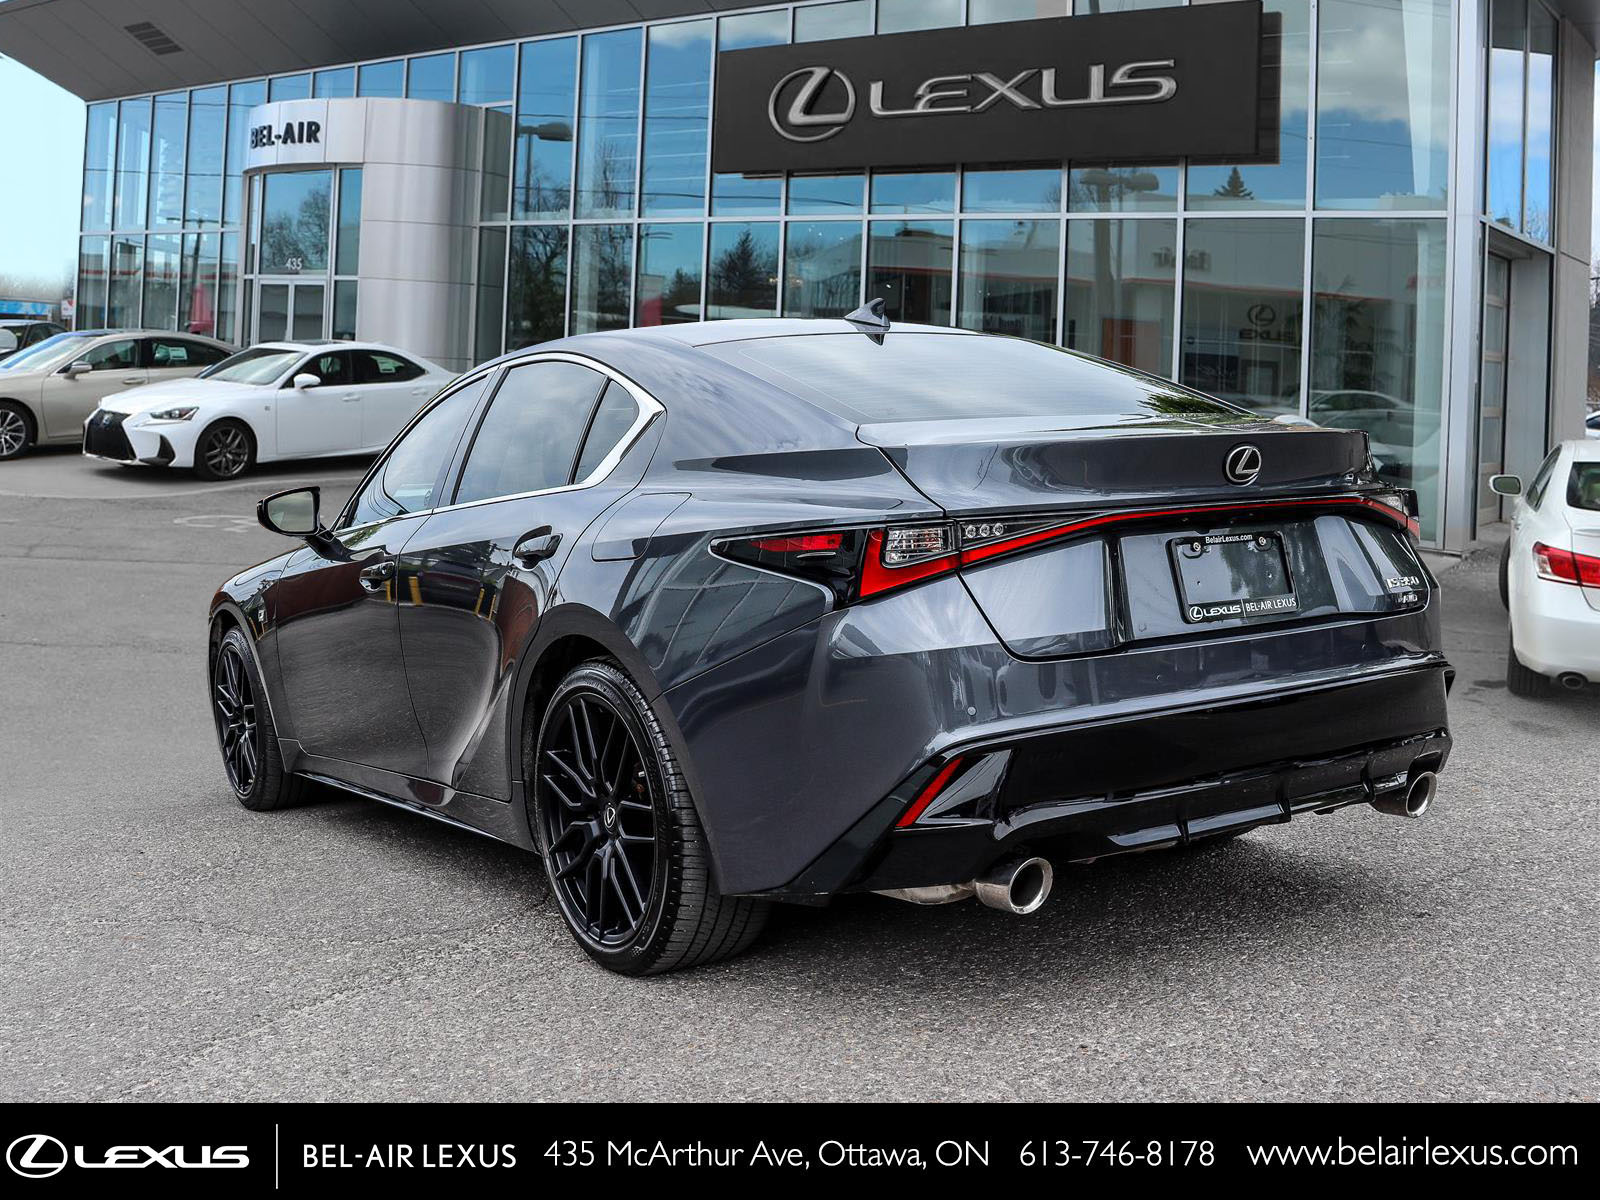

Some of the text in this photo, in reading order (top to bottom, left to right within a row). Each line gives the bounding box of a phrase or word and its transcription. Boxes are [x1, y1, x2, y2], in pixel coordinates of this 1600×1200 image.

[869, 58, 1178, 118] LEXUS
[250, 120, 321, 149] BEL-AIR
[285, 257, 303, 270] 435
[1205, 534, 1253, 544] BelairLexus.com
[1203, 597, 1297, 617] LEXUS BEL-AIR LEXUS
